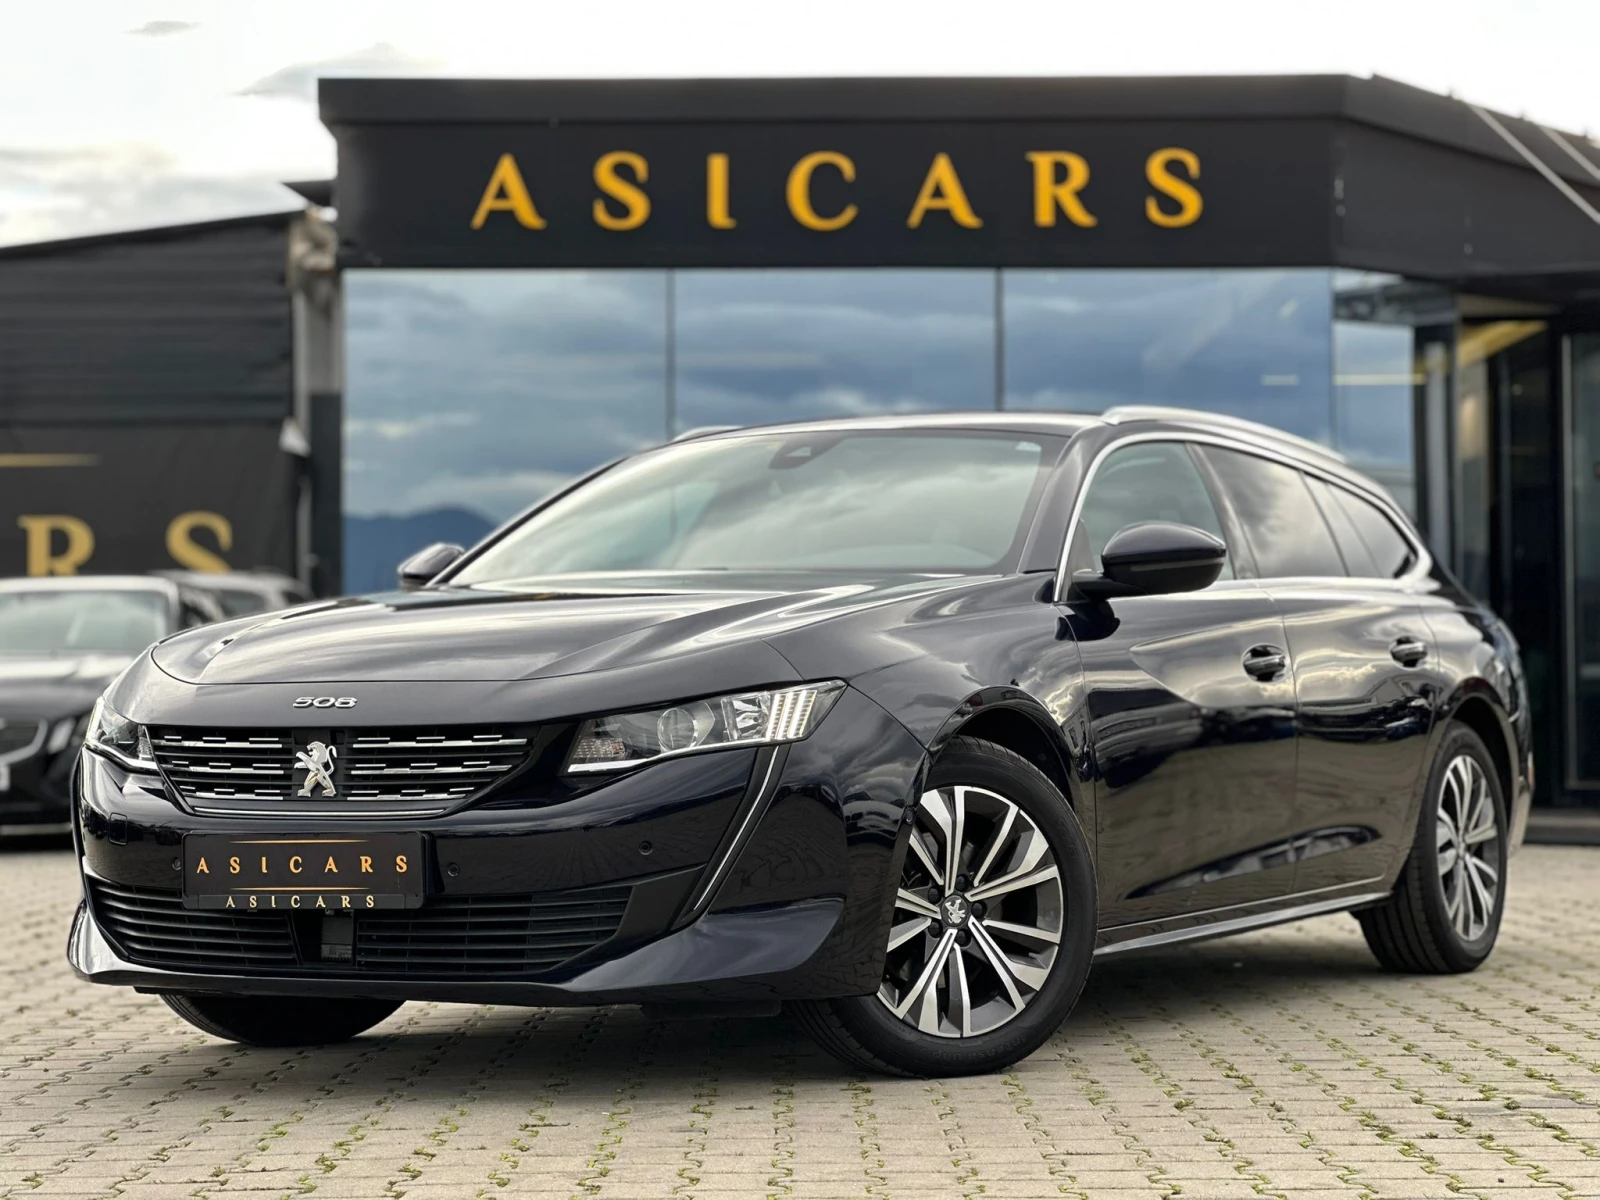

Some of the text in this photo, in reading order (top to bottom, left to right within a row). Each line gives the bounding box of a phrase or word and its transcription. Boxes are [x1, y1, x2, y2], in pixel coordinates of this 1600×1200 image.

[471, 147, 1203, 231] ASICARS
[293, 697, 358, 709] 508
[196, 855, 408, 874] ASICARS
[225, 895, 375, 909] ASICARS
